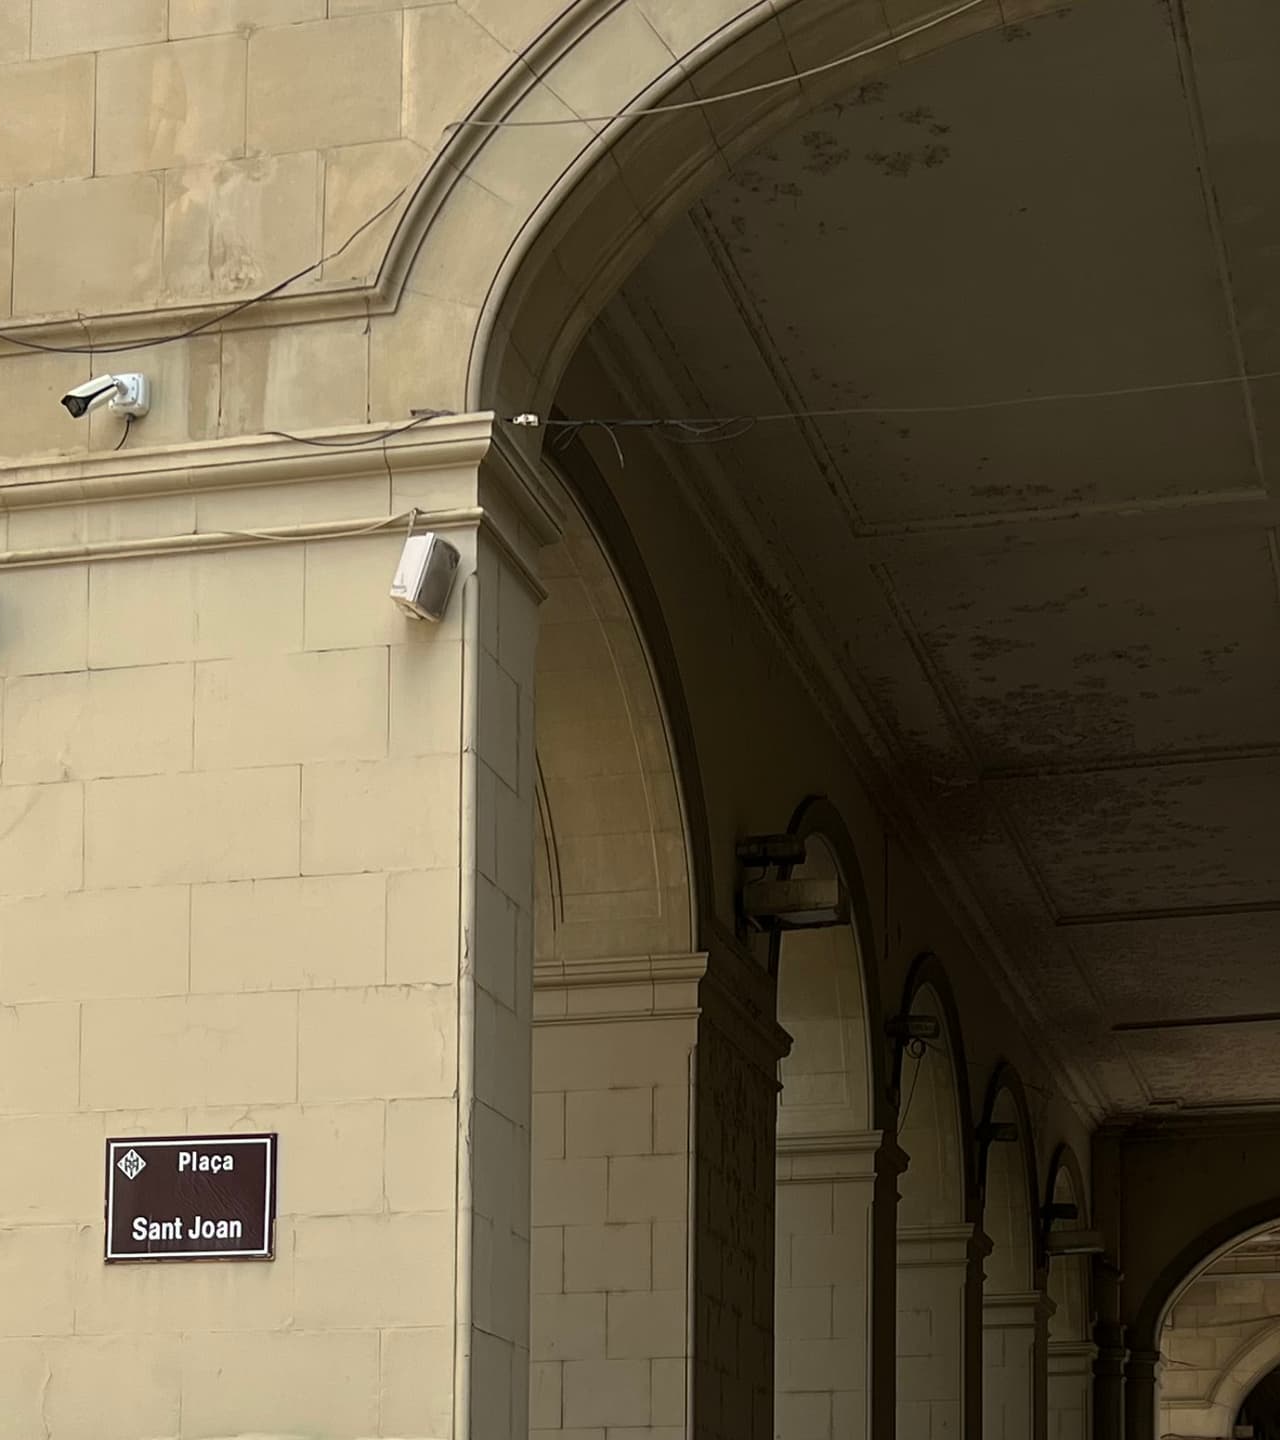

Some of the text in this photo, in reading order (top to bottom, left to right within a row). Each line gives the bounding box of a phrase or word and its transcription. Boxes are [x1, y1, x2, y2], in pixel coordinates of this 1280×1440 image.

[178, 1151, 234, 1174] Plaça
[132, 1215, 242, 1241] Sant Joan
